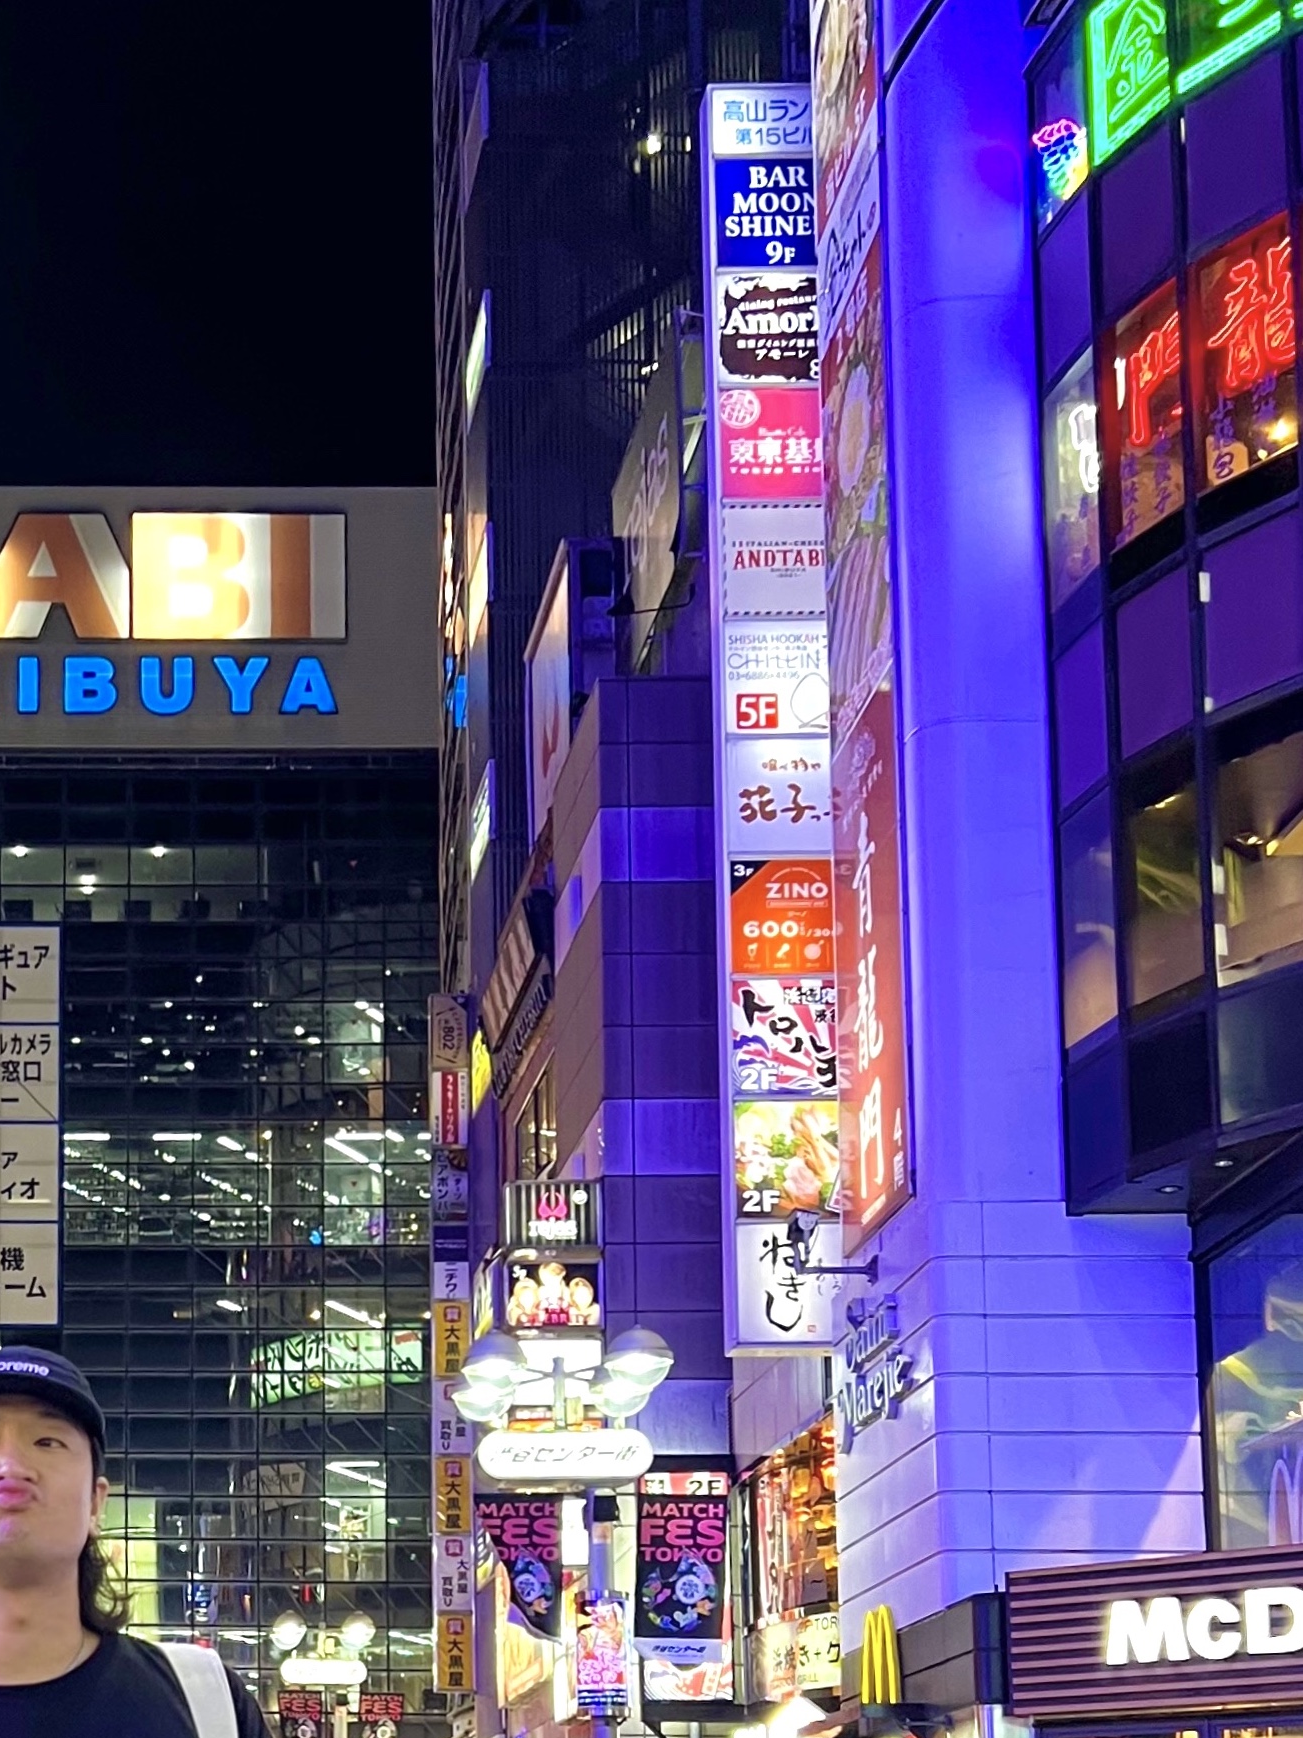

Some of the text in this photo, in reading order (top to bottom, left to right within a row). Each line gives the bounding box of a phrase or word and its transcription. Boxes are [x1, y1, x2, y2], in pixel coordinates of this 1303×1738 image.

[748, 165, 808, 188] BAR
[724, 215, 815, 237] SHINE
[764, 240, 796, 264] 9F
[738, 696, 777, 728] 5F
[733, 864, 754, 877] 3F
[765, 882, 829, 899] ZINO
[743, 920, 800, 938] 600
[739, 1068, 778, 1091] 2F
[742, 1189, 781, 1213] 2F
[478, 1502, 561, 1518] MATCH
[641, 1502, 725, 1519] MATCH
[639, 1518, 726, 1547] FES
[497, 1546, 560, 1562] OKYO
[447, 1638, 465, 1687] 大黒屋
